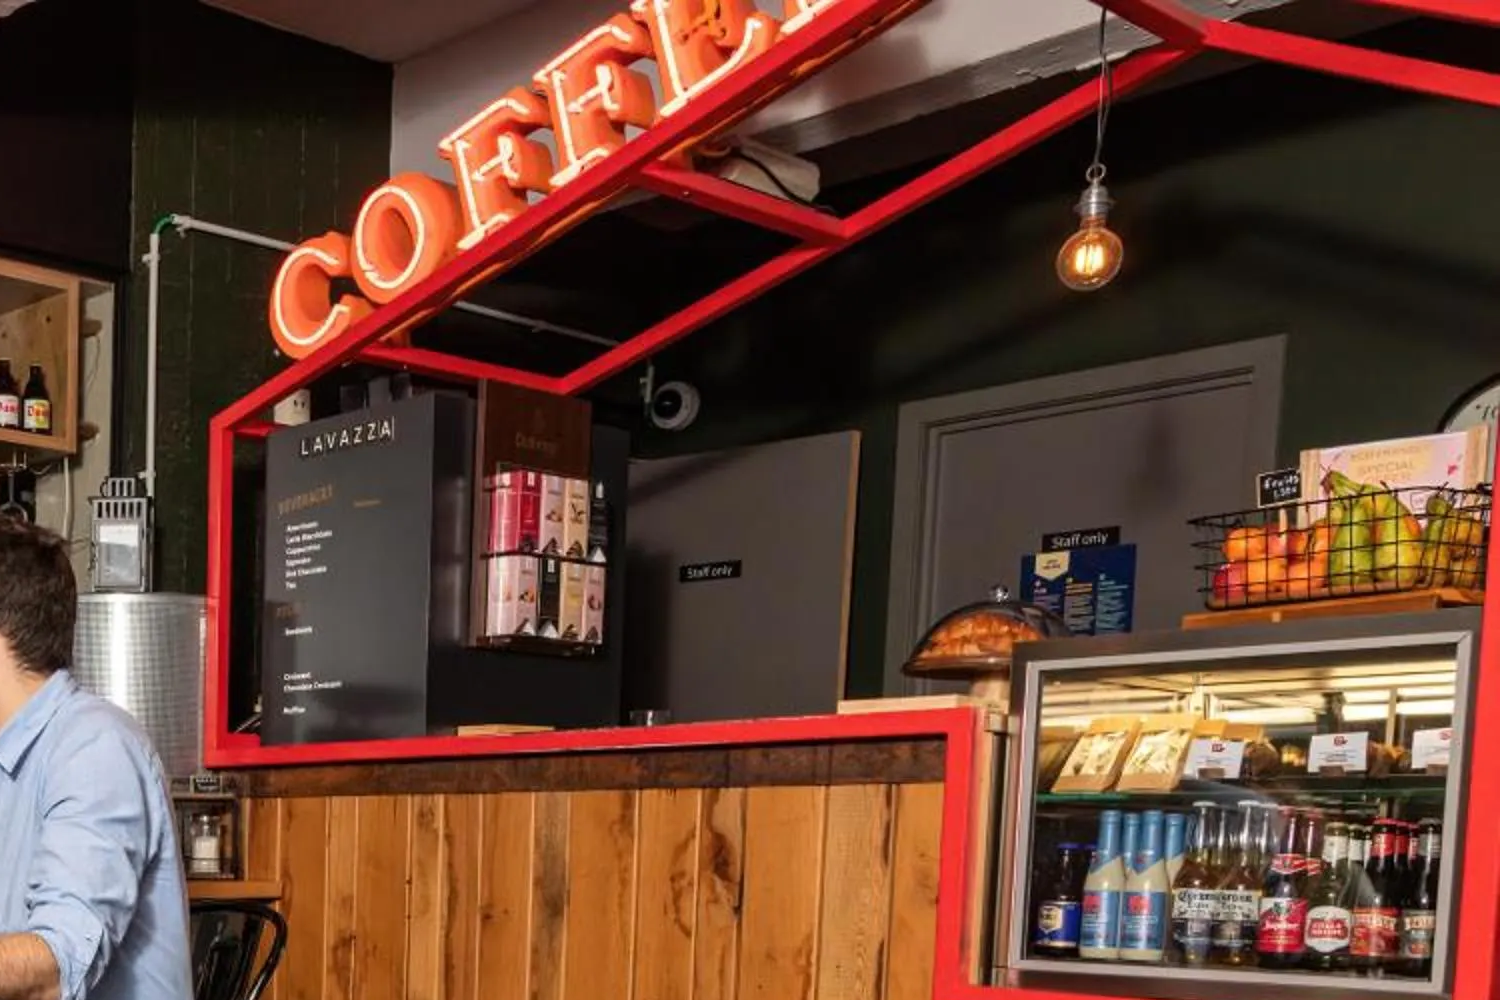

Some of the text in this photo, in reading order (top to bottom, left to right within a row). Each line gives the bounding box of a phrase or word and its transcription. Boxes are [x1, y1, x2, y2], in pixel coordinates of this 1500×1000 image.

[270, 0, 842, 360] COFFE
[301, 420, 391, 456] LAVAZZA
[1051, 531, 1109, 549] Staff only
[687, 565, 733, 579] Staff only
